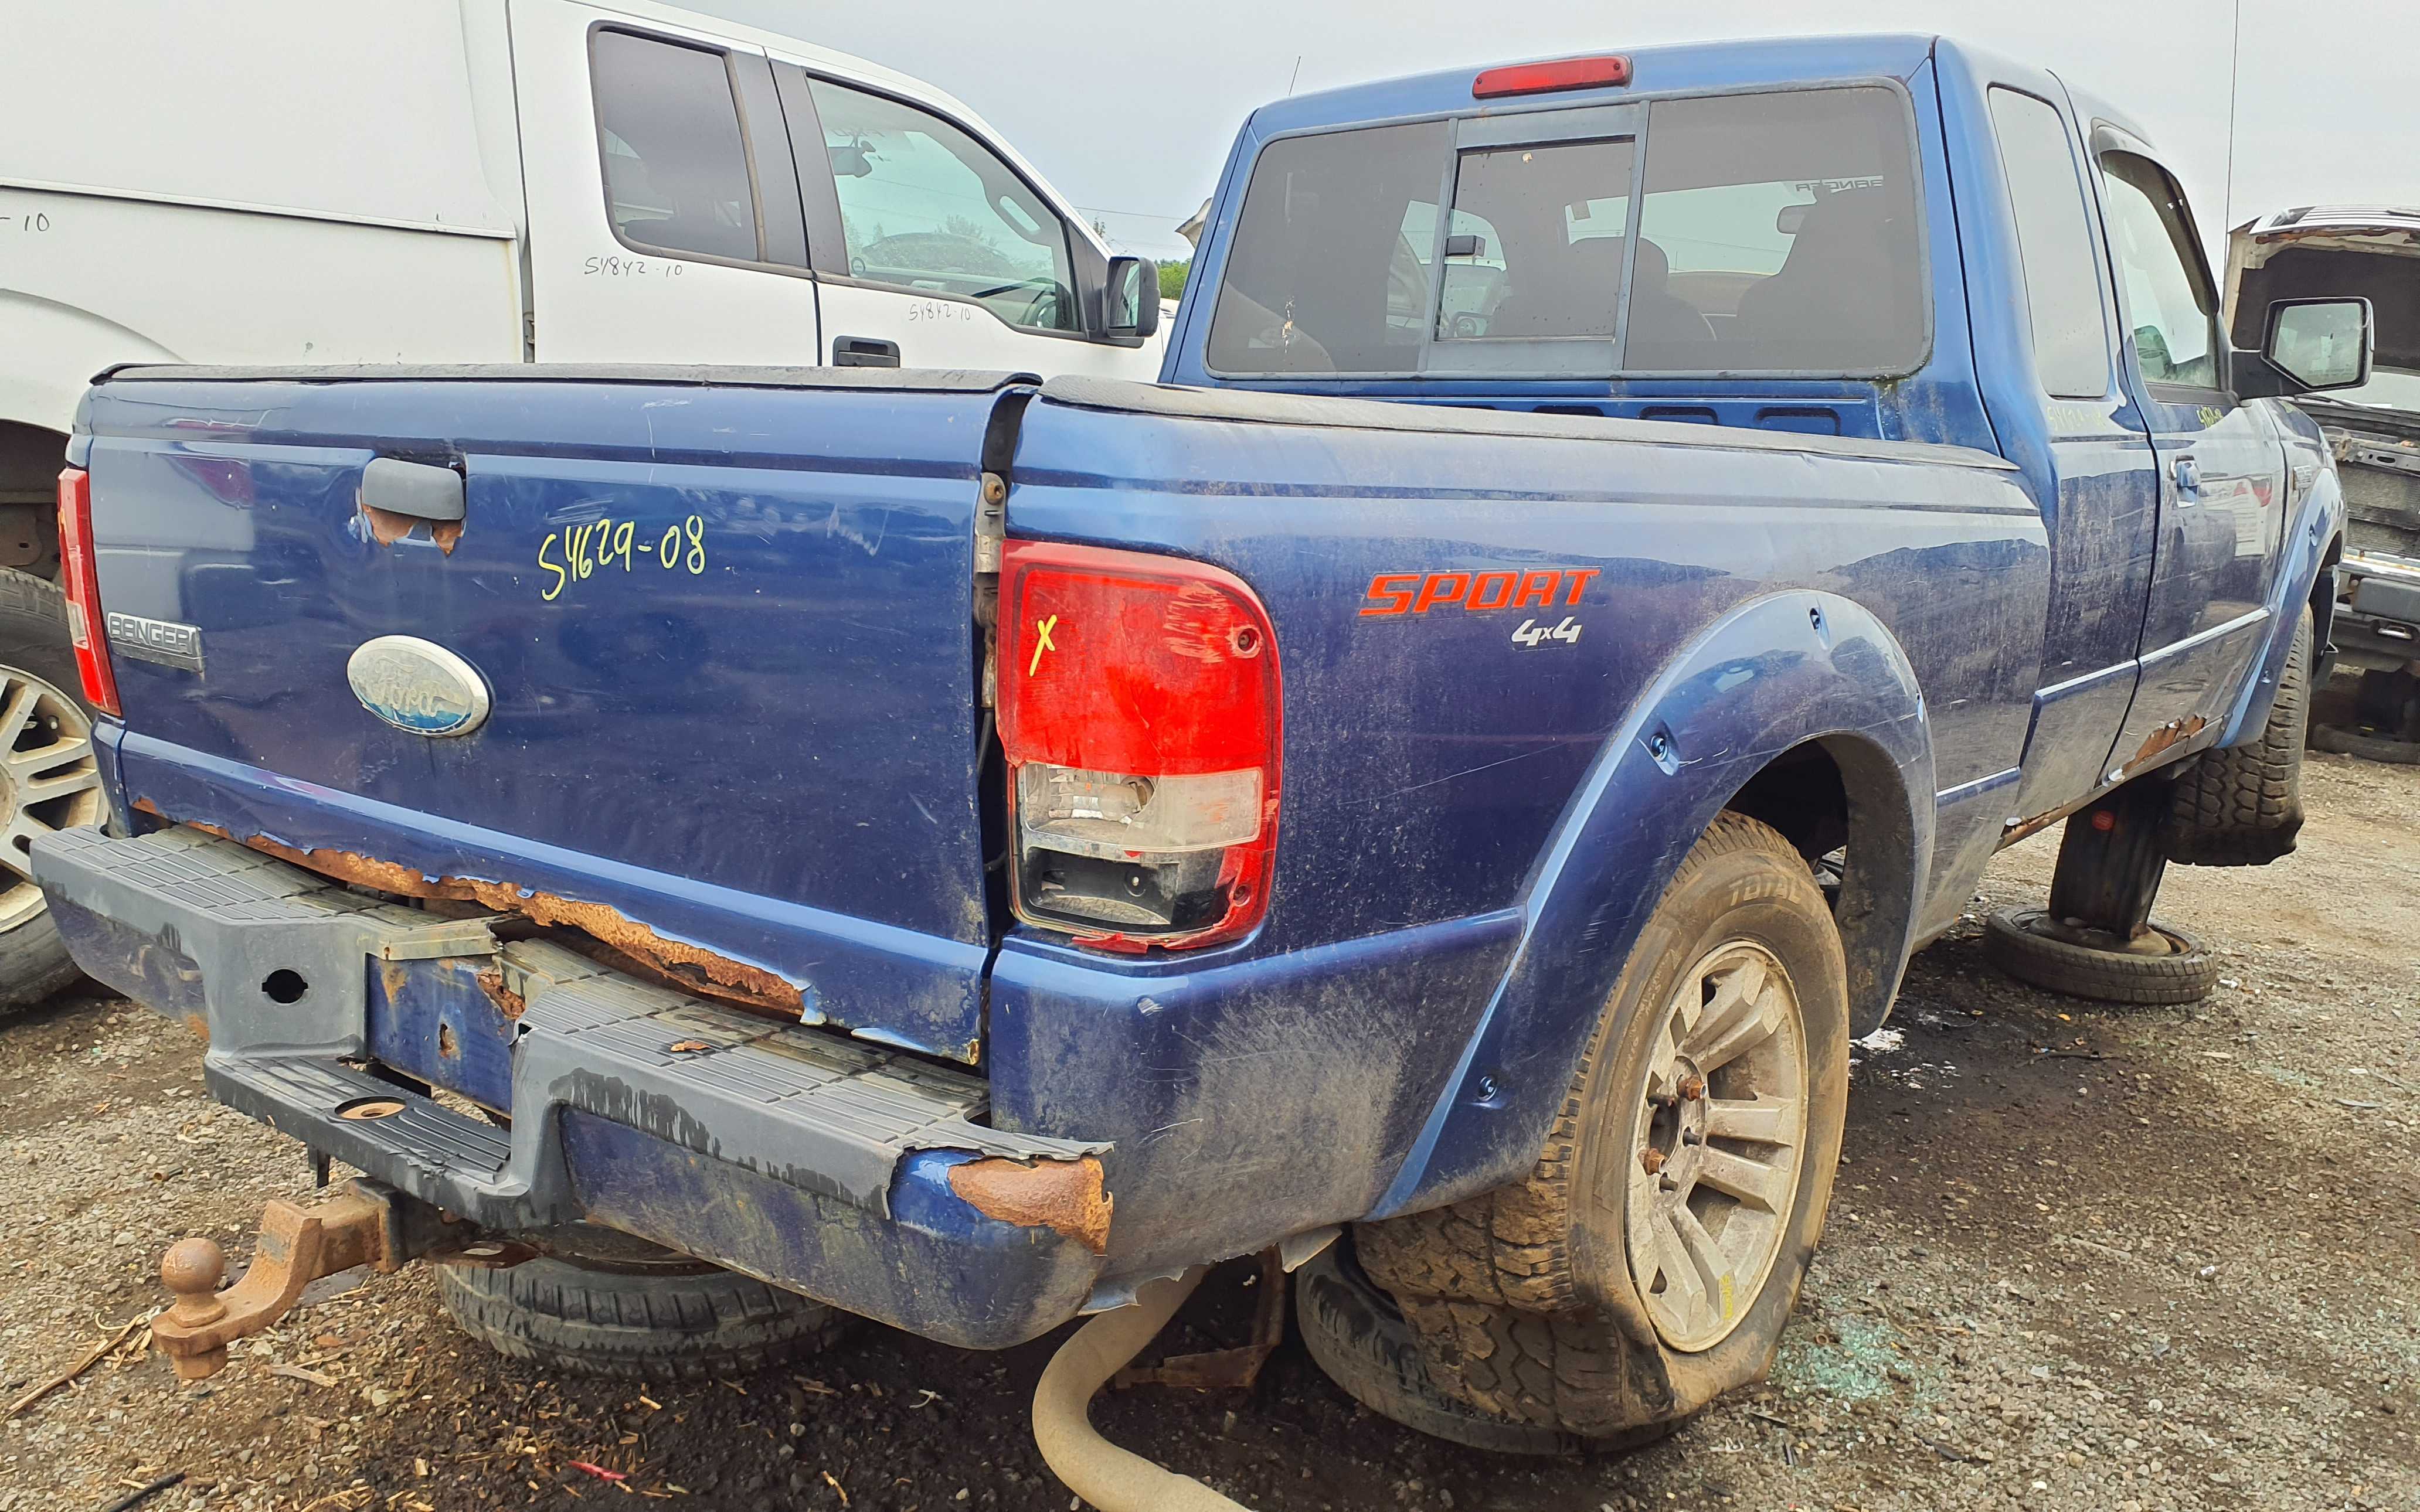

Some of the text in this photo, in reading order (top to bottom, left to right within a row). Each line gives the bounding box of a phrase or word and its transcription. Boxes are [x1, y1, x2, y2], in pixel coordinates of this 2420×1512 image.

[539, 515, 705, 600] S4629-08
[1359, 568, 1601, 617] SPORT
[109, 615, 191, 655] RANGER
[1511, 617, 1583, 646] 4x4
